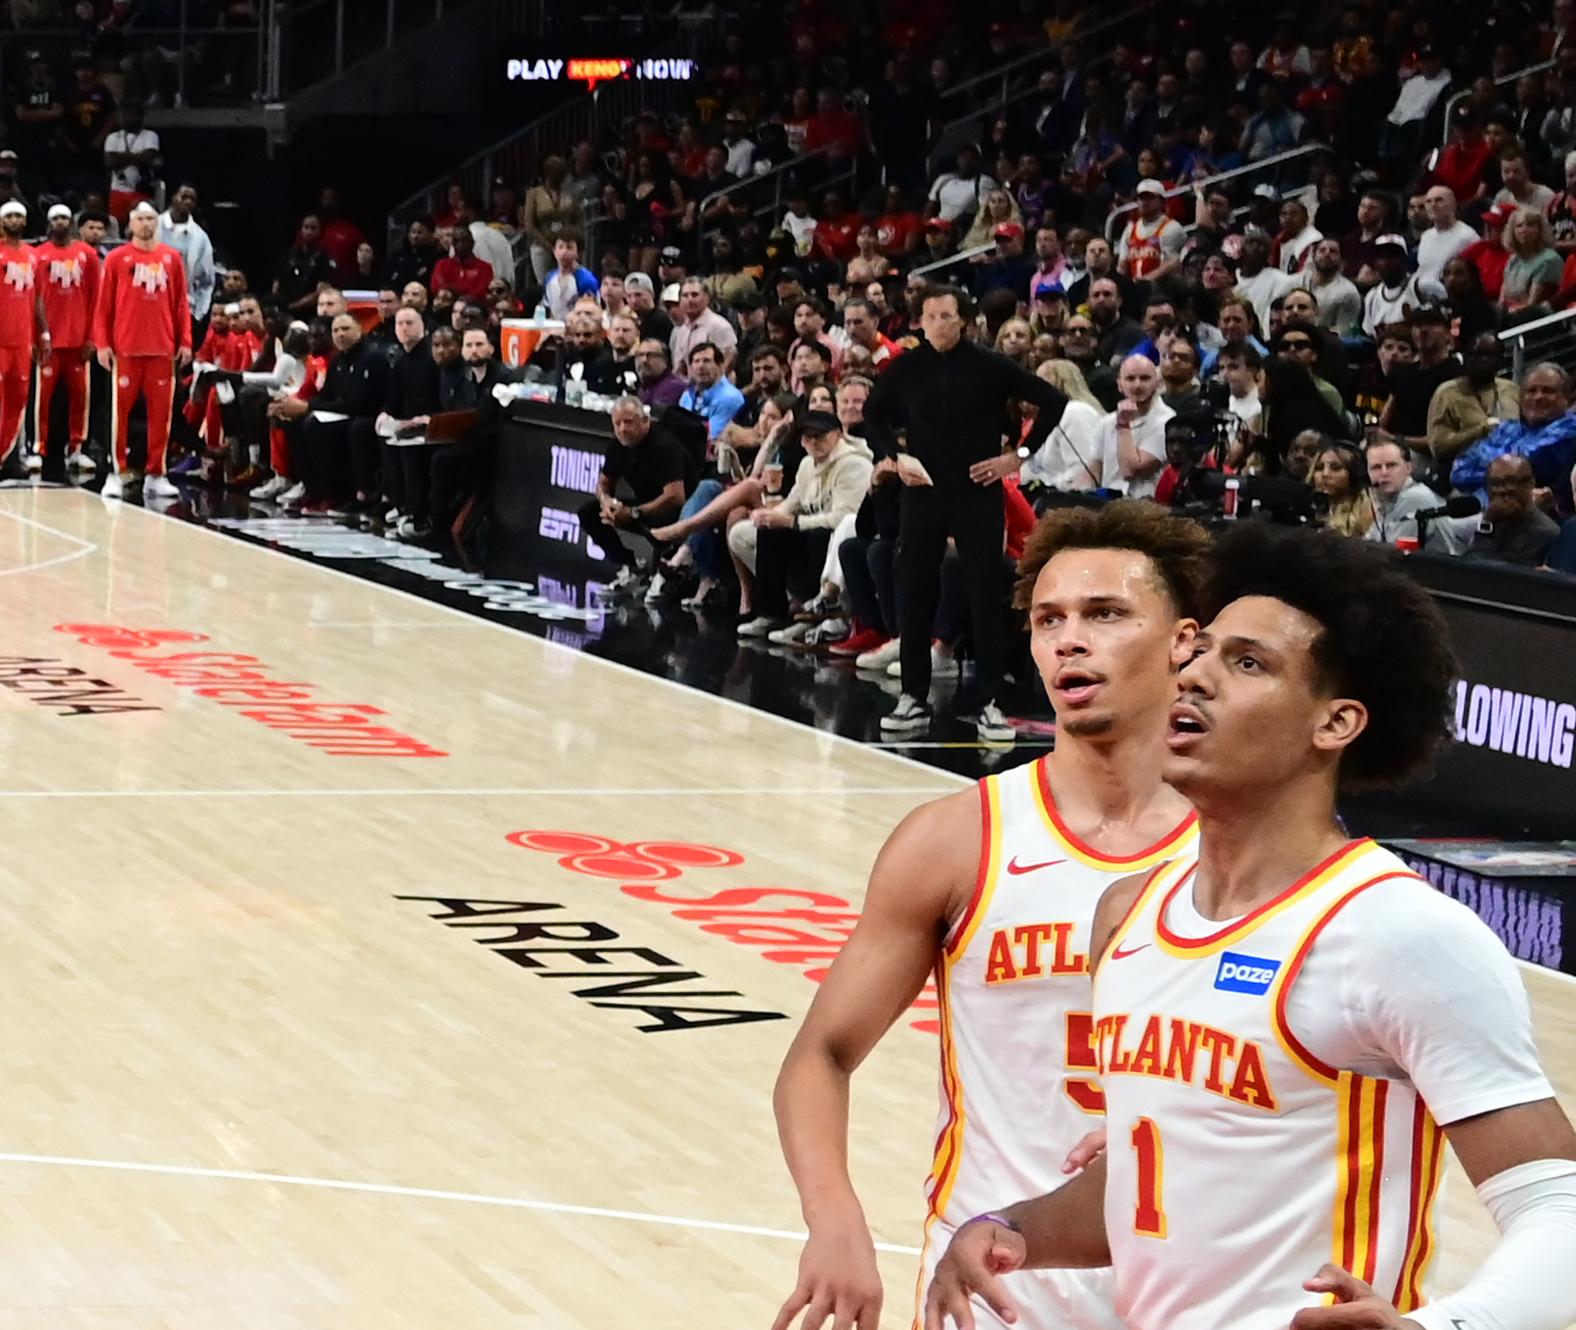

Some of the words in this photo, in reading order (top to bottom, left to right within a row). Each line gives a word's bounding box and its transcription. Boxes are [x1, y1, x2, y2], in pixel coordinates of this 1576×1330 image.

[506, 58, 564, 80] PLAY
[550, 444, 606, 495] TONIGH
[392, 894, 791, 1033] ARENA
[1218, 959, 1276, 986] paze
[1095, 1013, 1281, 1113] TLANTA
[1129, 1115, 1168, 1240] 1
